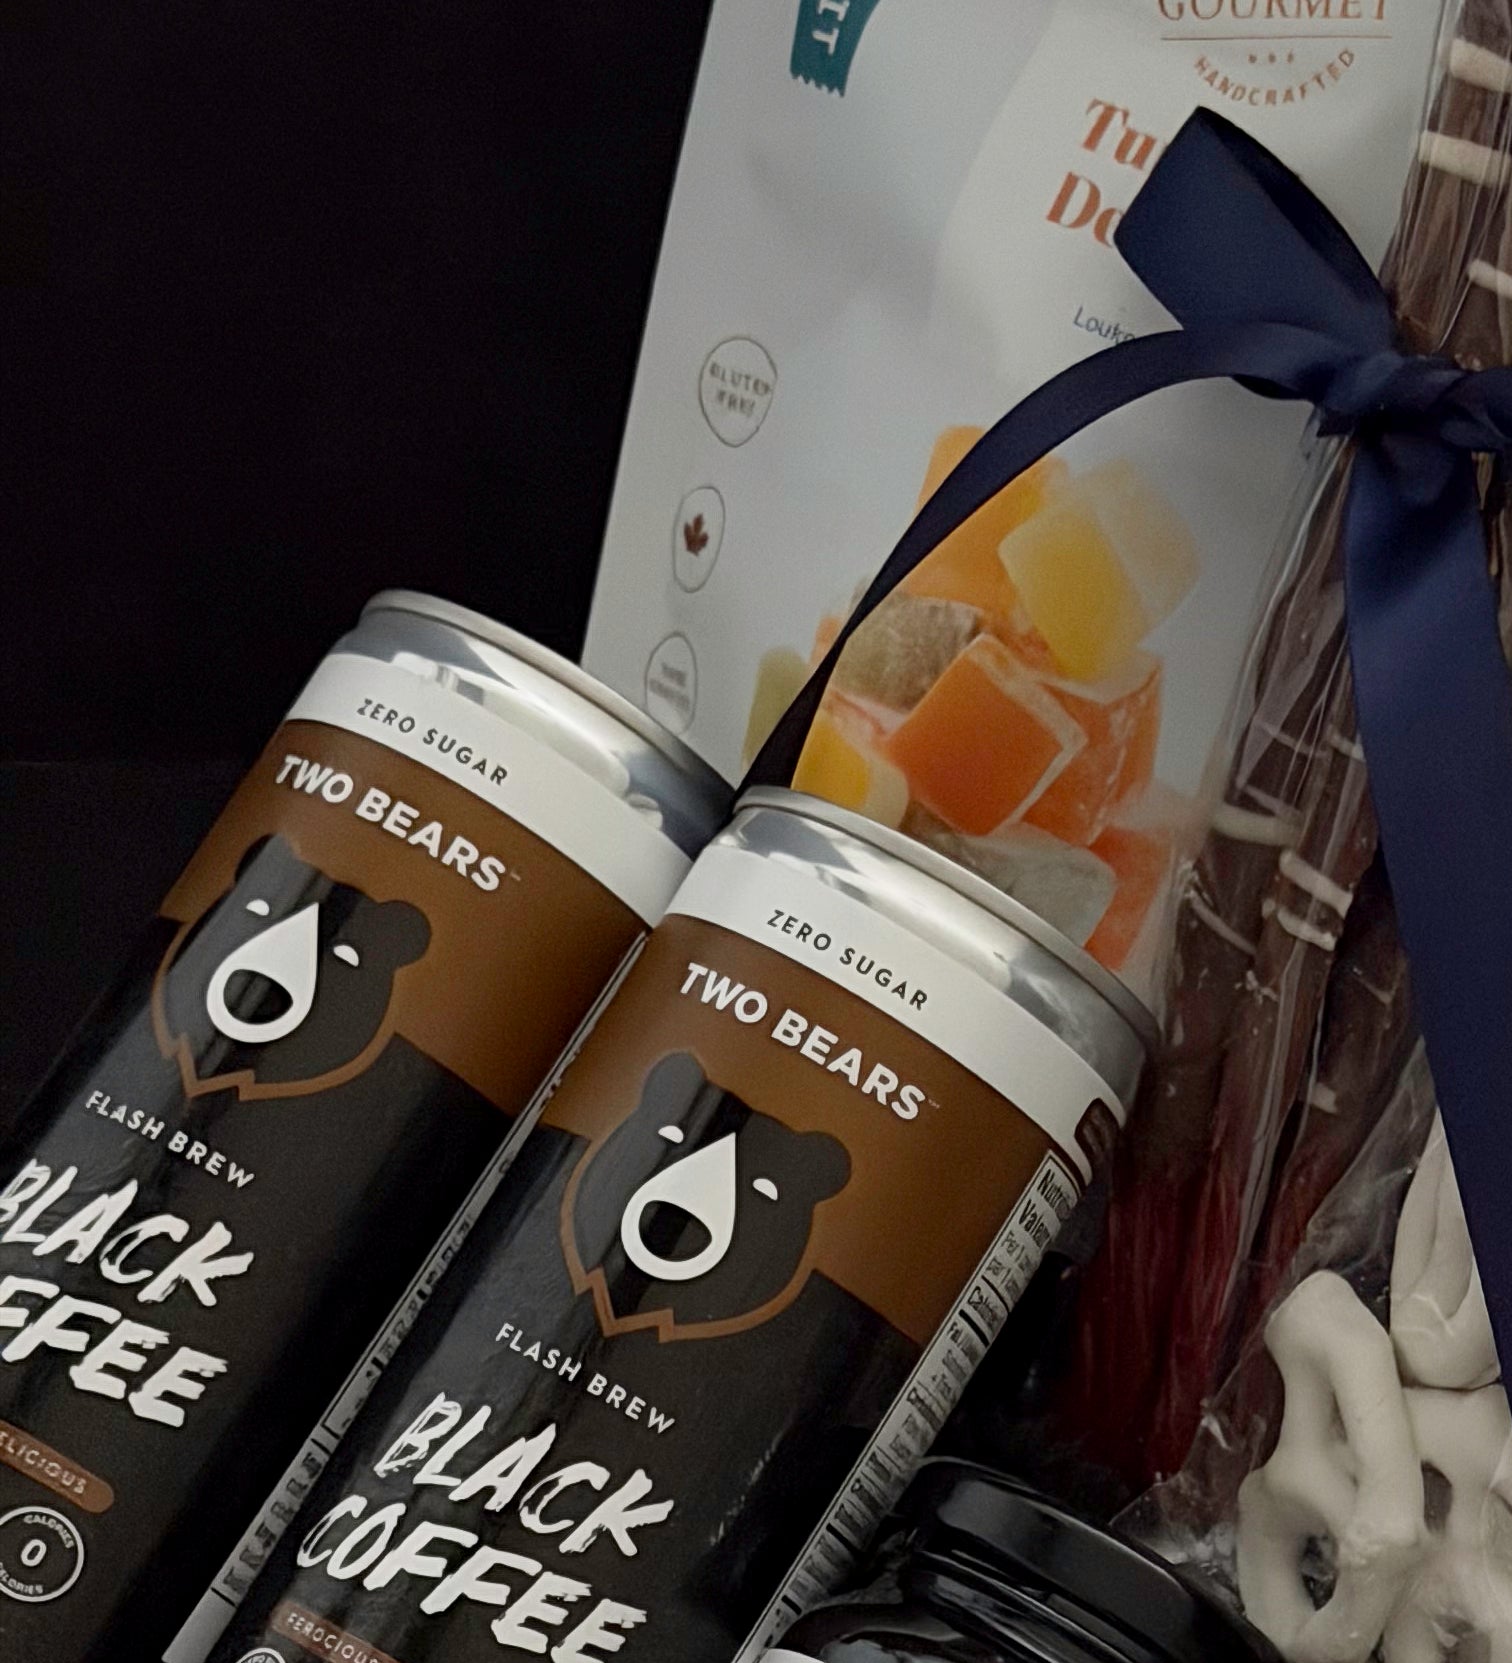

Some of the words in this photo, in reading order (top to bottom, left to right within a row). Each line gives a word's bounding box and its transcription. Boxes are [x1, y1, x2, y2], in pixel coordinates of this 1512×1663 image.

[1194, 49, 1354, 106] HANDCRAFTED
[356, 698, 416, 735] ZERO
[422, 727, 509, 787] SUGAR
[275, 754, 354, 804] TWO
[354, 787, 507, 892] BEARS
[765, 909, 832, 952] ZERO
[839, 946, 929, 1012] SUGAR
[679, 962, 770, 1025] TWO
[770, 1007, 927, 1120] BEARS
[85, 1090, 165, 1140] FLASH
[167, 1131, 255, 1188] BREW
[495, 1322, 578, 1384] FLASH
[586, 1371, 677, 1435] BREW
[372, 1391, 676, 1557] BLACK
[20, 1538, 47, 1567] 0
